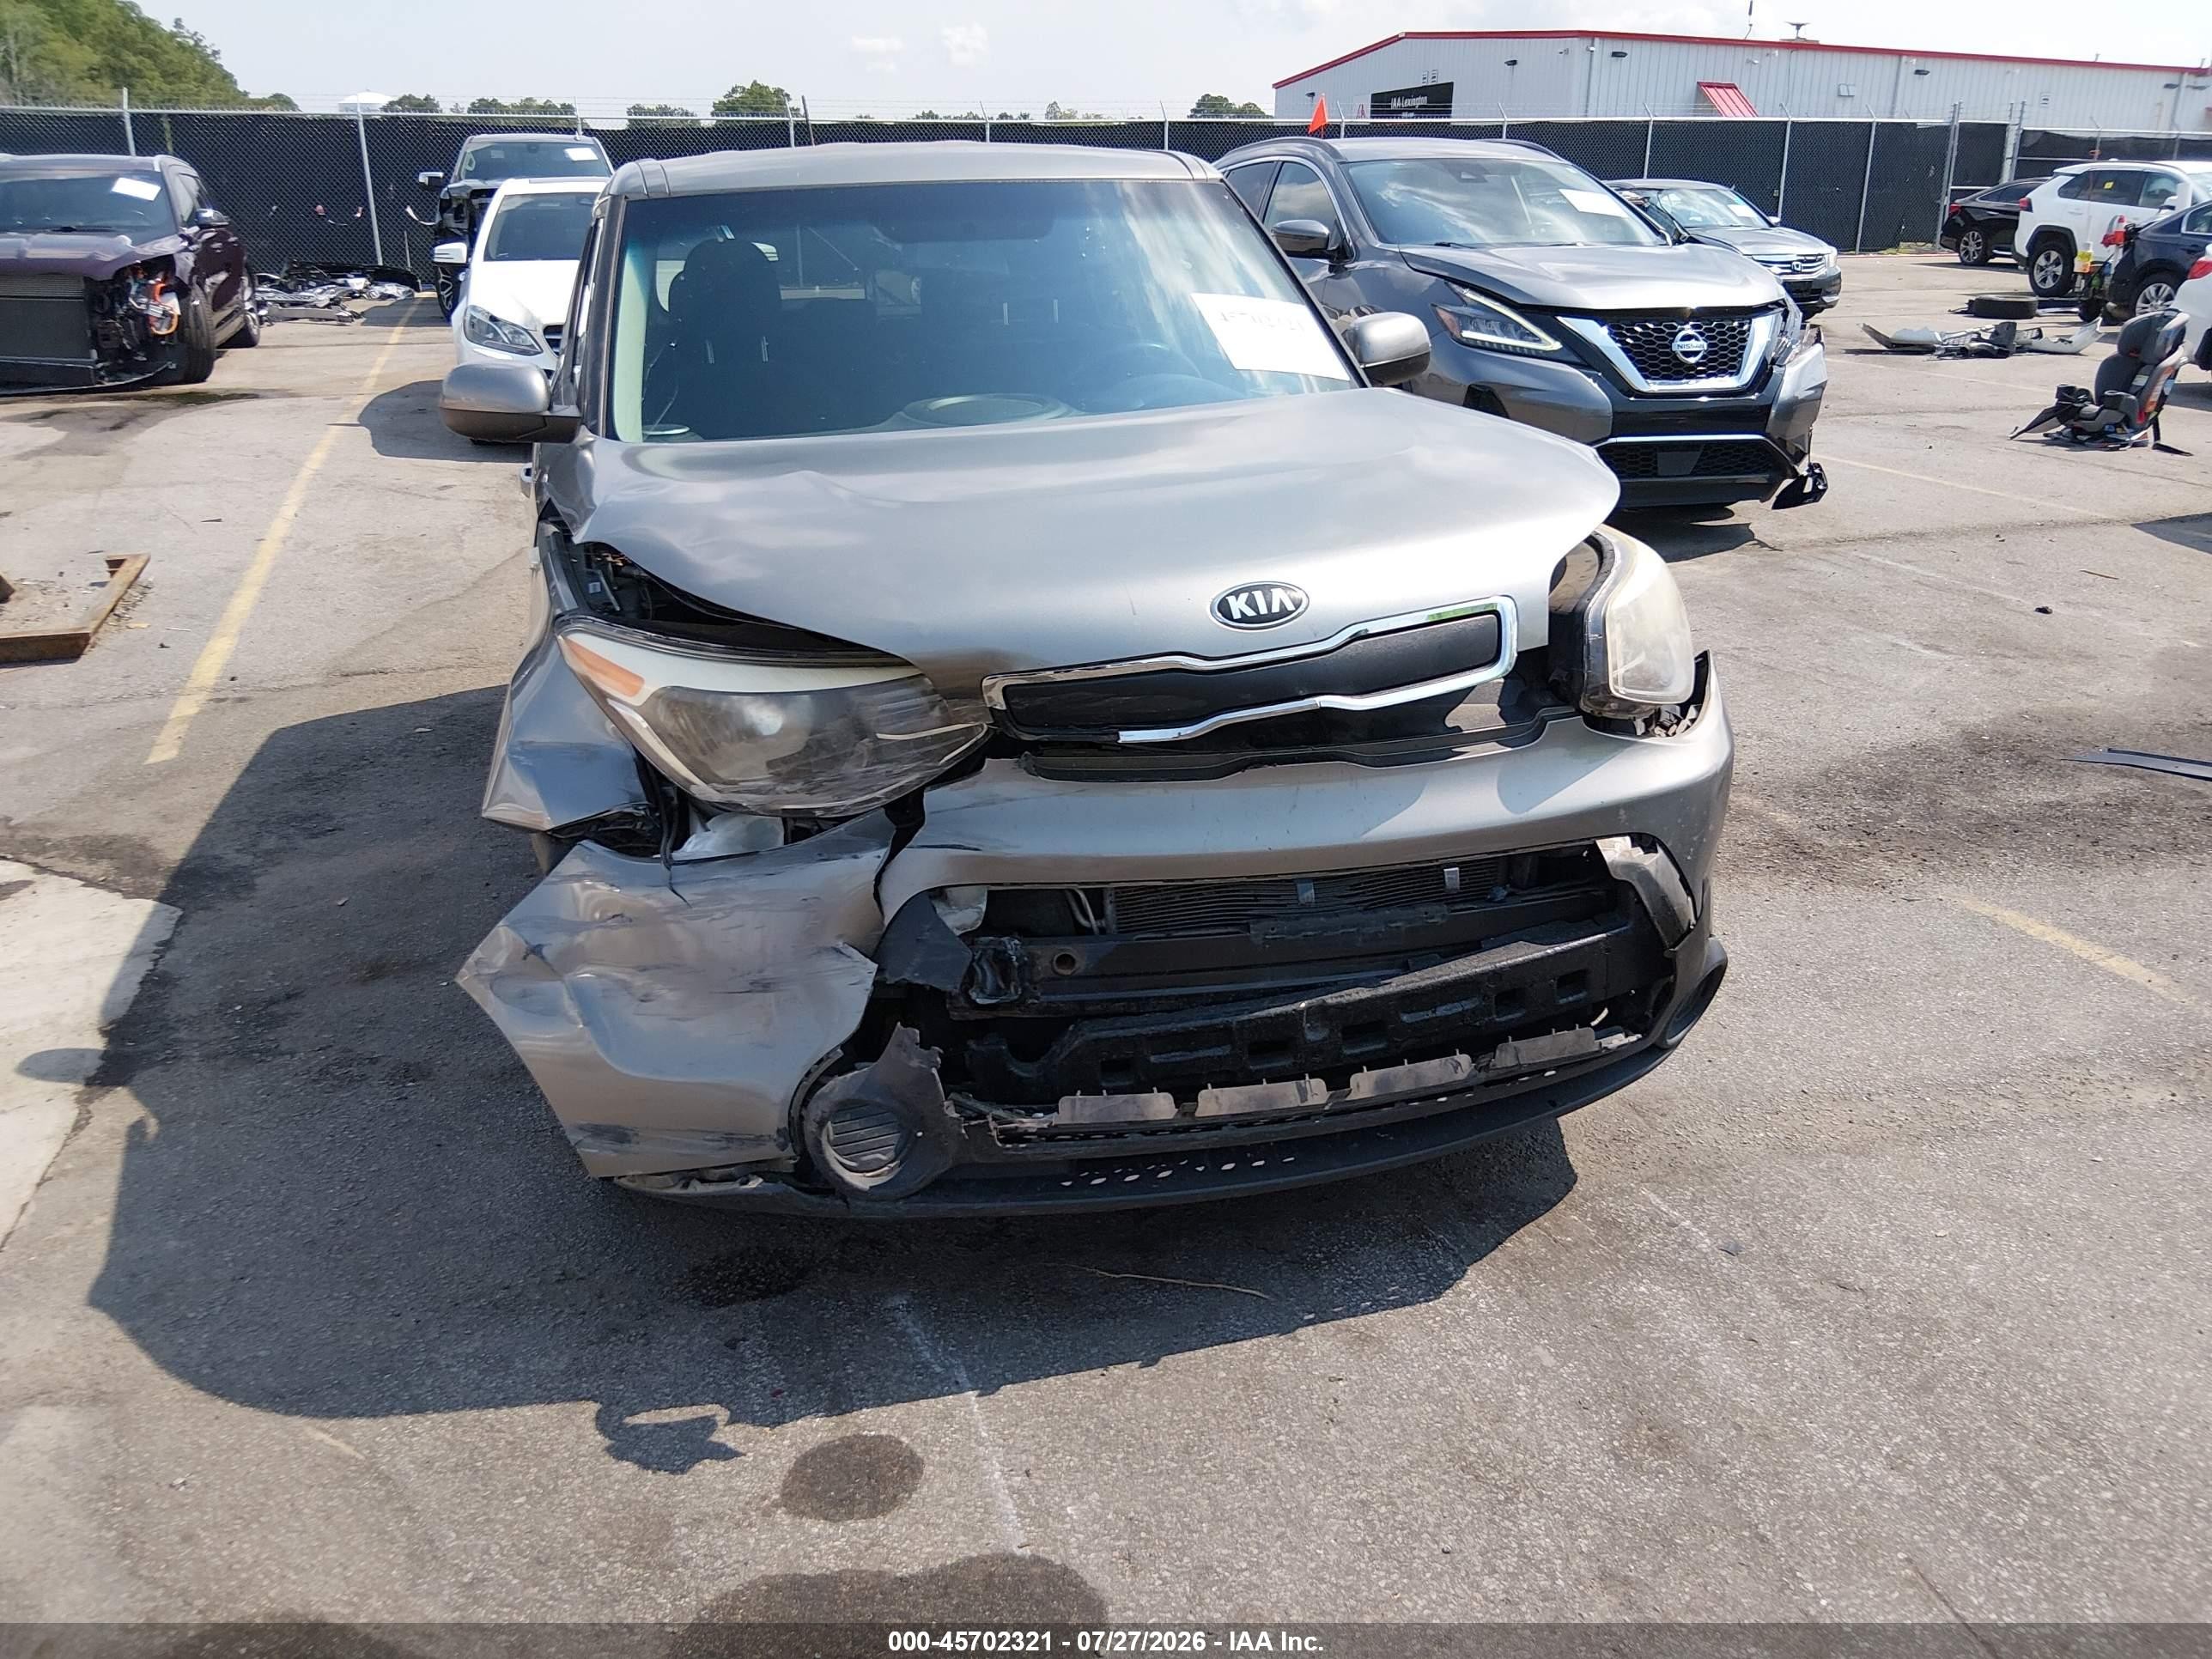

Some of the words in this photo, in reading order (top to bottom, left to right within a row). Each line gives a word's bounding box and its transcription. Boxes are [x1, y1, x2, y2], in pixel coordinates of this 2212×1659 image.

[1390, 96, 1401, 110] IAA
[1401, 94, 1428, 109] Lexington
[1225, 587, 1296, 620] KIA
